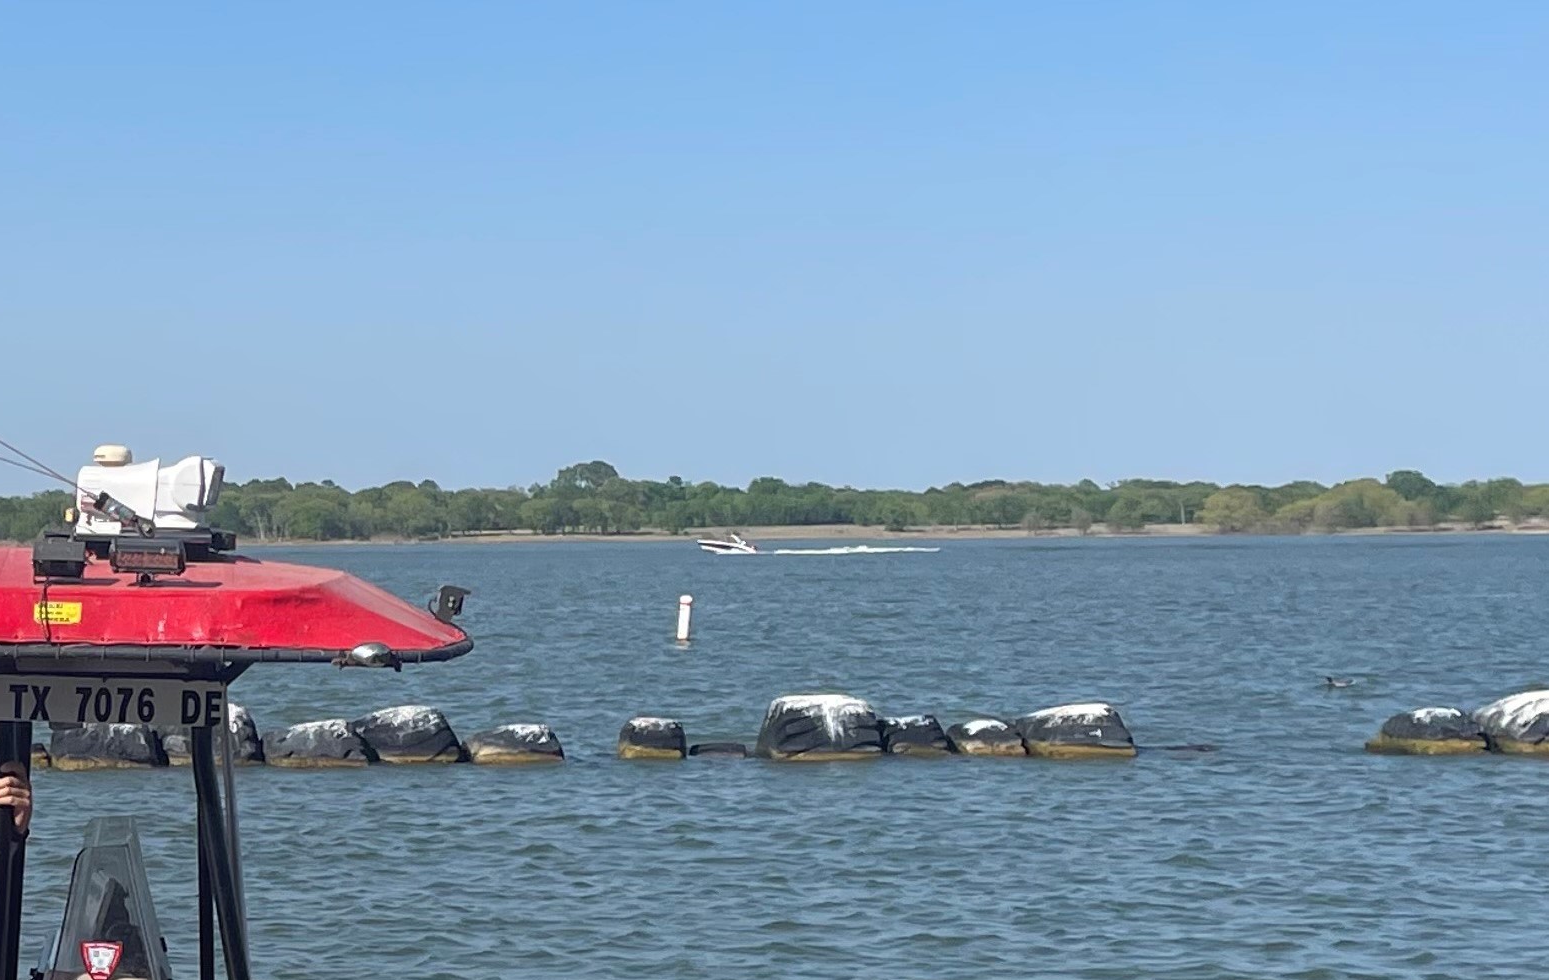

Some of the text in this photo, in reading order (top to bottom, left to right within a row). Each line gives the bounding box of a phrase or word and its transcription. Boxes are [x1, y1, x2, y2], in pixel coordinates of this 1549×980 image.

[9, 684, 222, 726] TX 7076 DE
